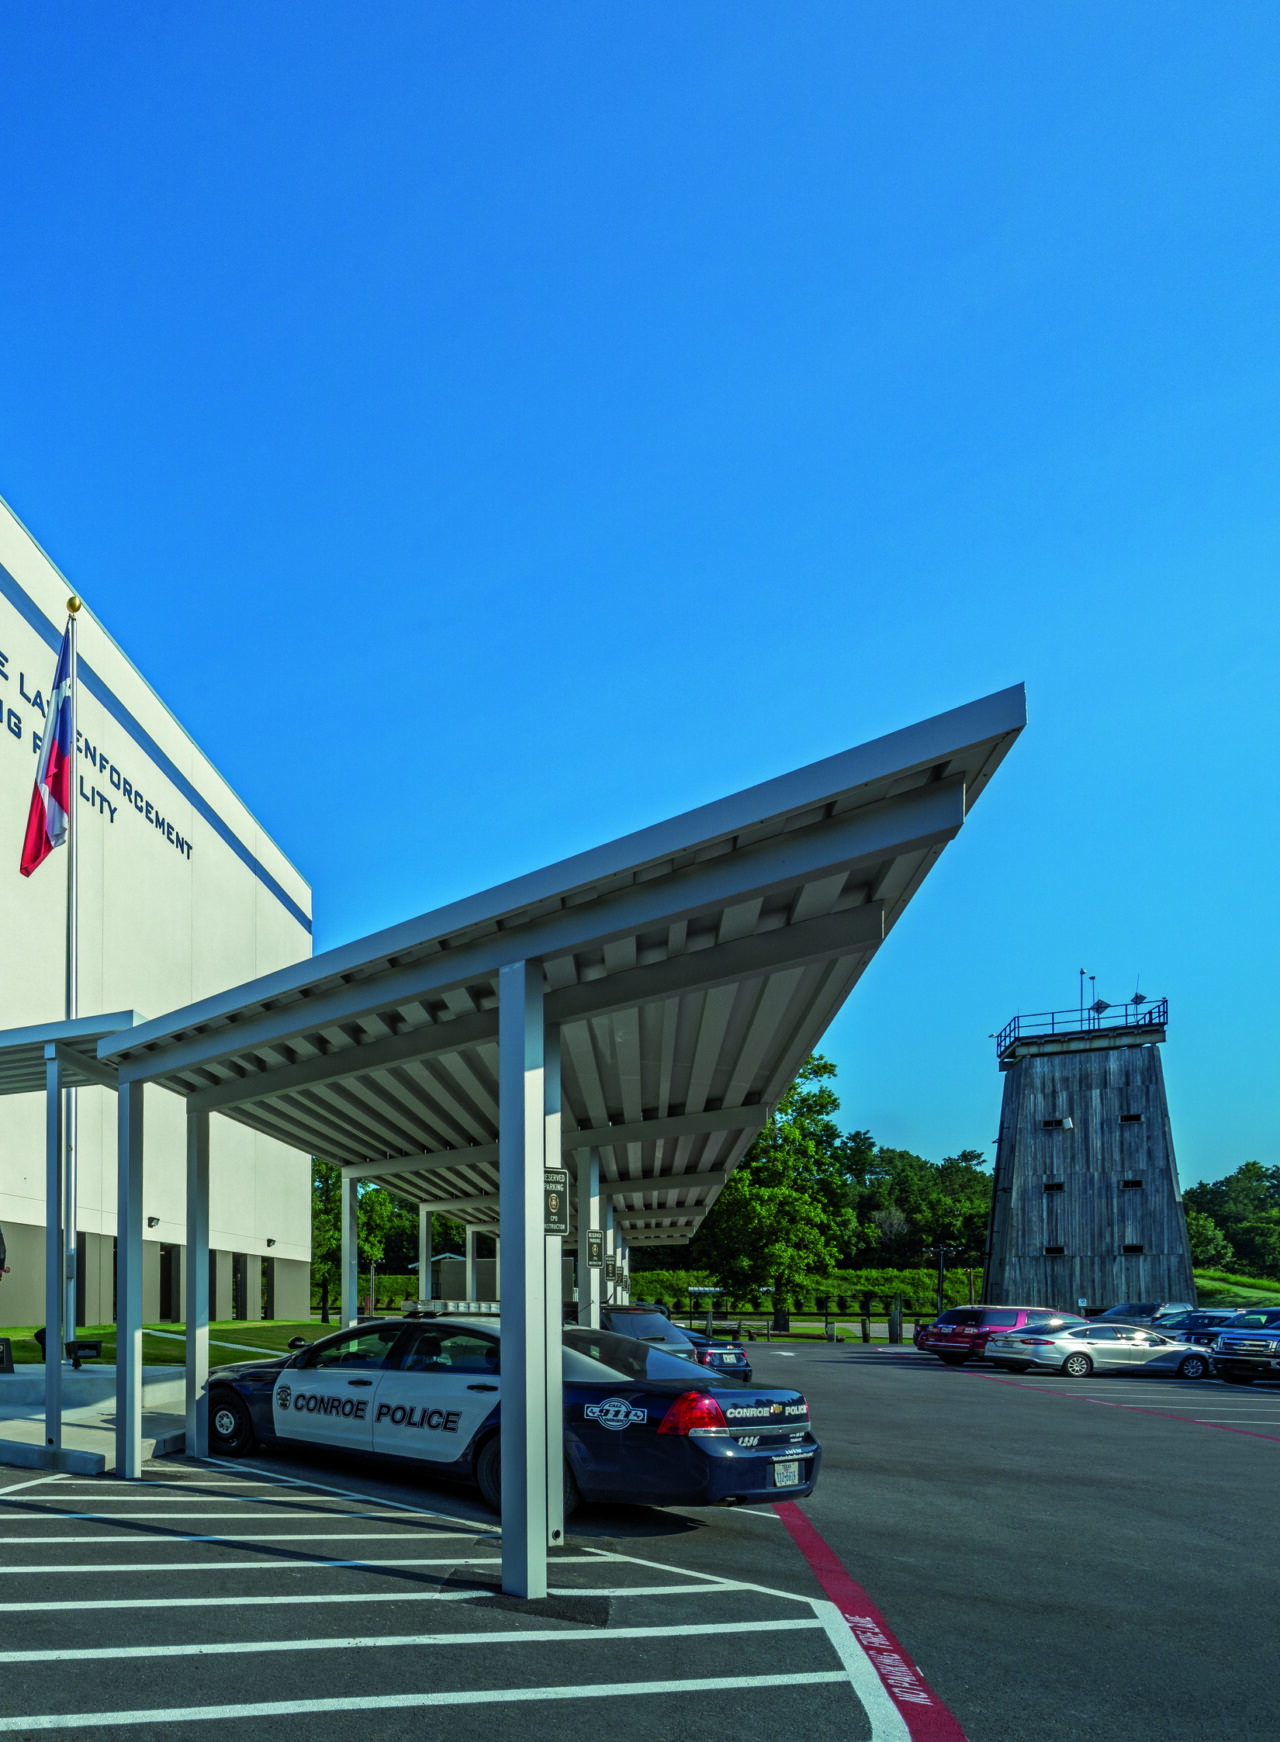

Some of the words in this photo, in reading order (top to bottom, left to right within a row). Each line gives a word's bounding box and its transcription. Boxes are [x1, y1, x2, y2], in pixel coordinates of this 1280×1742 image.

[20, 672, 50, 718] LA
[76, 730, 192, 860] ENFORCEMENT
[33, 731, 117, 823] FLITY
[544, 1183, 564, 1191] PARKING
[294, 1393, 369, 1420] CONROE
[375, 1403, 462, 1433] POLICE
[597, 1408, 632, 1418] 911
[726, 1408, 770, 1418] CONROE
[785, 1405, 807, 1416] POLICE
[868, 1650, 923, 1690] PARKING
[891, 1687, 934, 1706] NO
